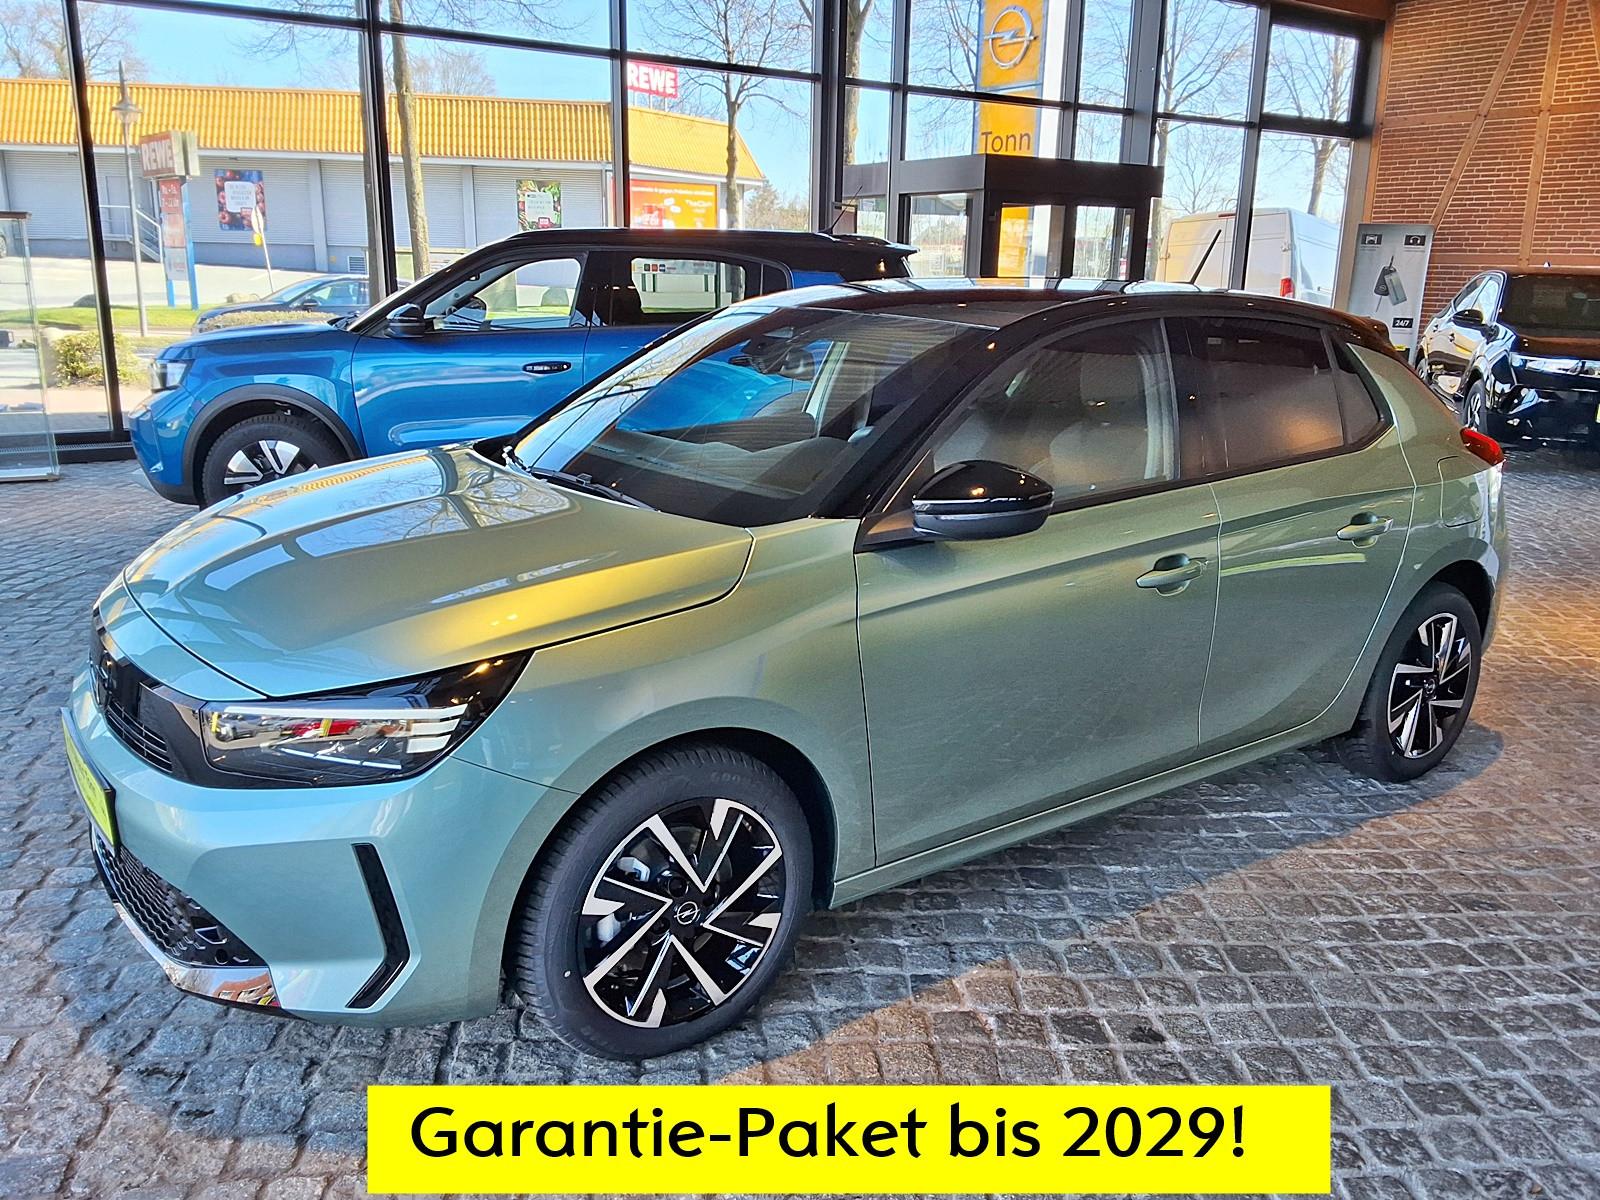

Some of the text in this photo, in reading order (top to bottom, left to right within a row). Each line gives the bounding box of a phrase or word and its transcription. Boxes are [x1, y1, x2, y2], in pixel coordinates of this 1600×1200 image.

[627, 62, 676, 94] REWE
[141, 139, 175, 170] REWE
[981, 131, 1031, 154] Tonn
